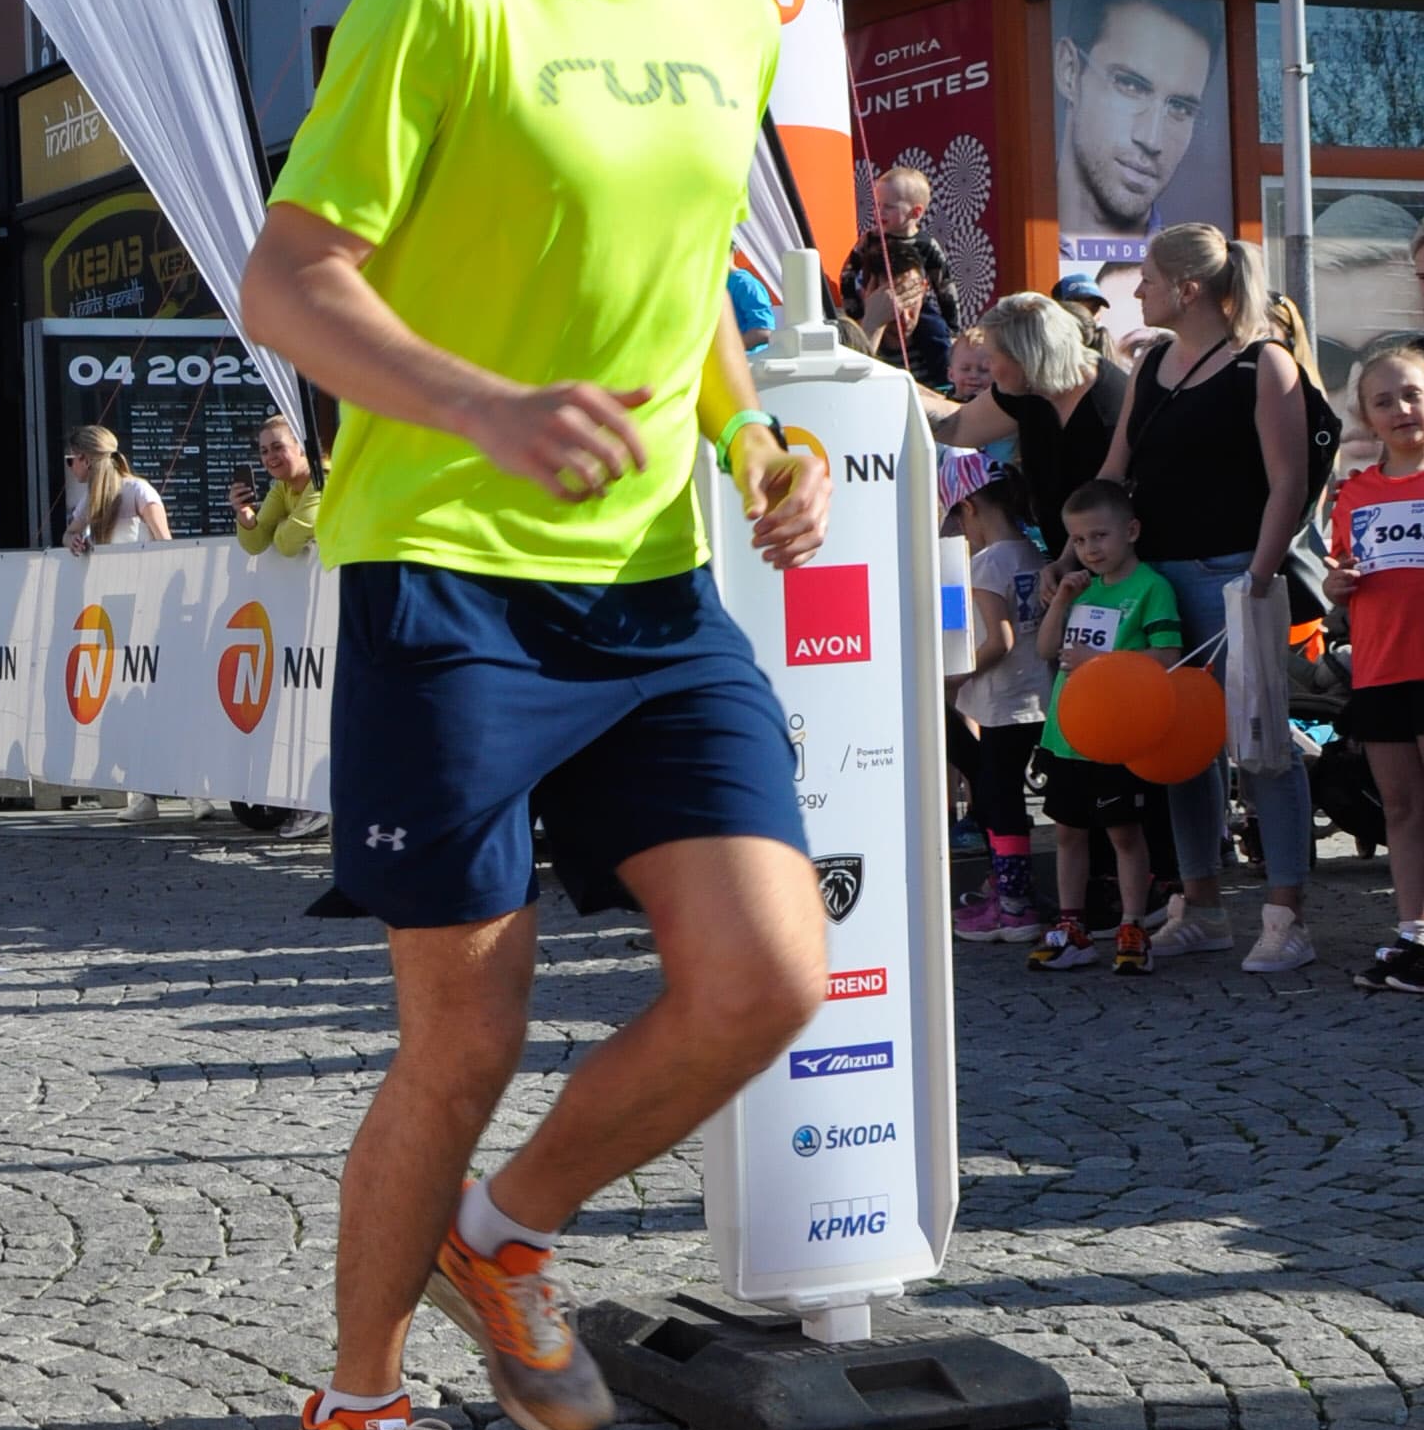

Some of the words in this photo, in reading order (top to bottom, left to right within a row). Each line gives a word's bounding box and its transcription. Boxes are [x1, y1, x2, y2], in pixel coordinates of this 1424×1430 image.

[874, 38, 942, 66] OPTIKA
[854, 60, 990, 118] UNETTES
[1081, 244, 1146, 259] LINDB
[68, 355, 135, 385] 04
[147, 355, 267, 385] 2023
[844, 453, 895, 483] NN
[1375, 523, 1424, 544] 304
[794, 635, 862, 658] AVON
[122, 645, 160, 683] NN
[283, 647, 324, 689] NN
[856, 745, 894, 757] Powered
[856, 760, 868, 770] by
[871, 757, 894, 768] MVM
[797, 792, 828, 809] ogy
[826, 973, 883, 996] TREND
[825, 1122, 896, 1149] ŠKODA
[807, 1211, 887, 1242] KPMG
